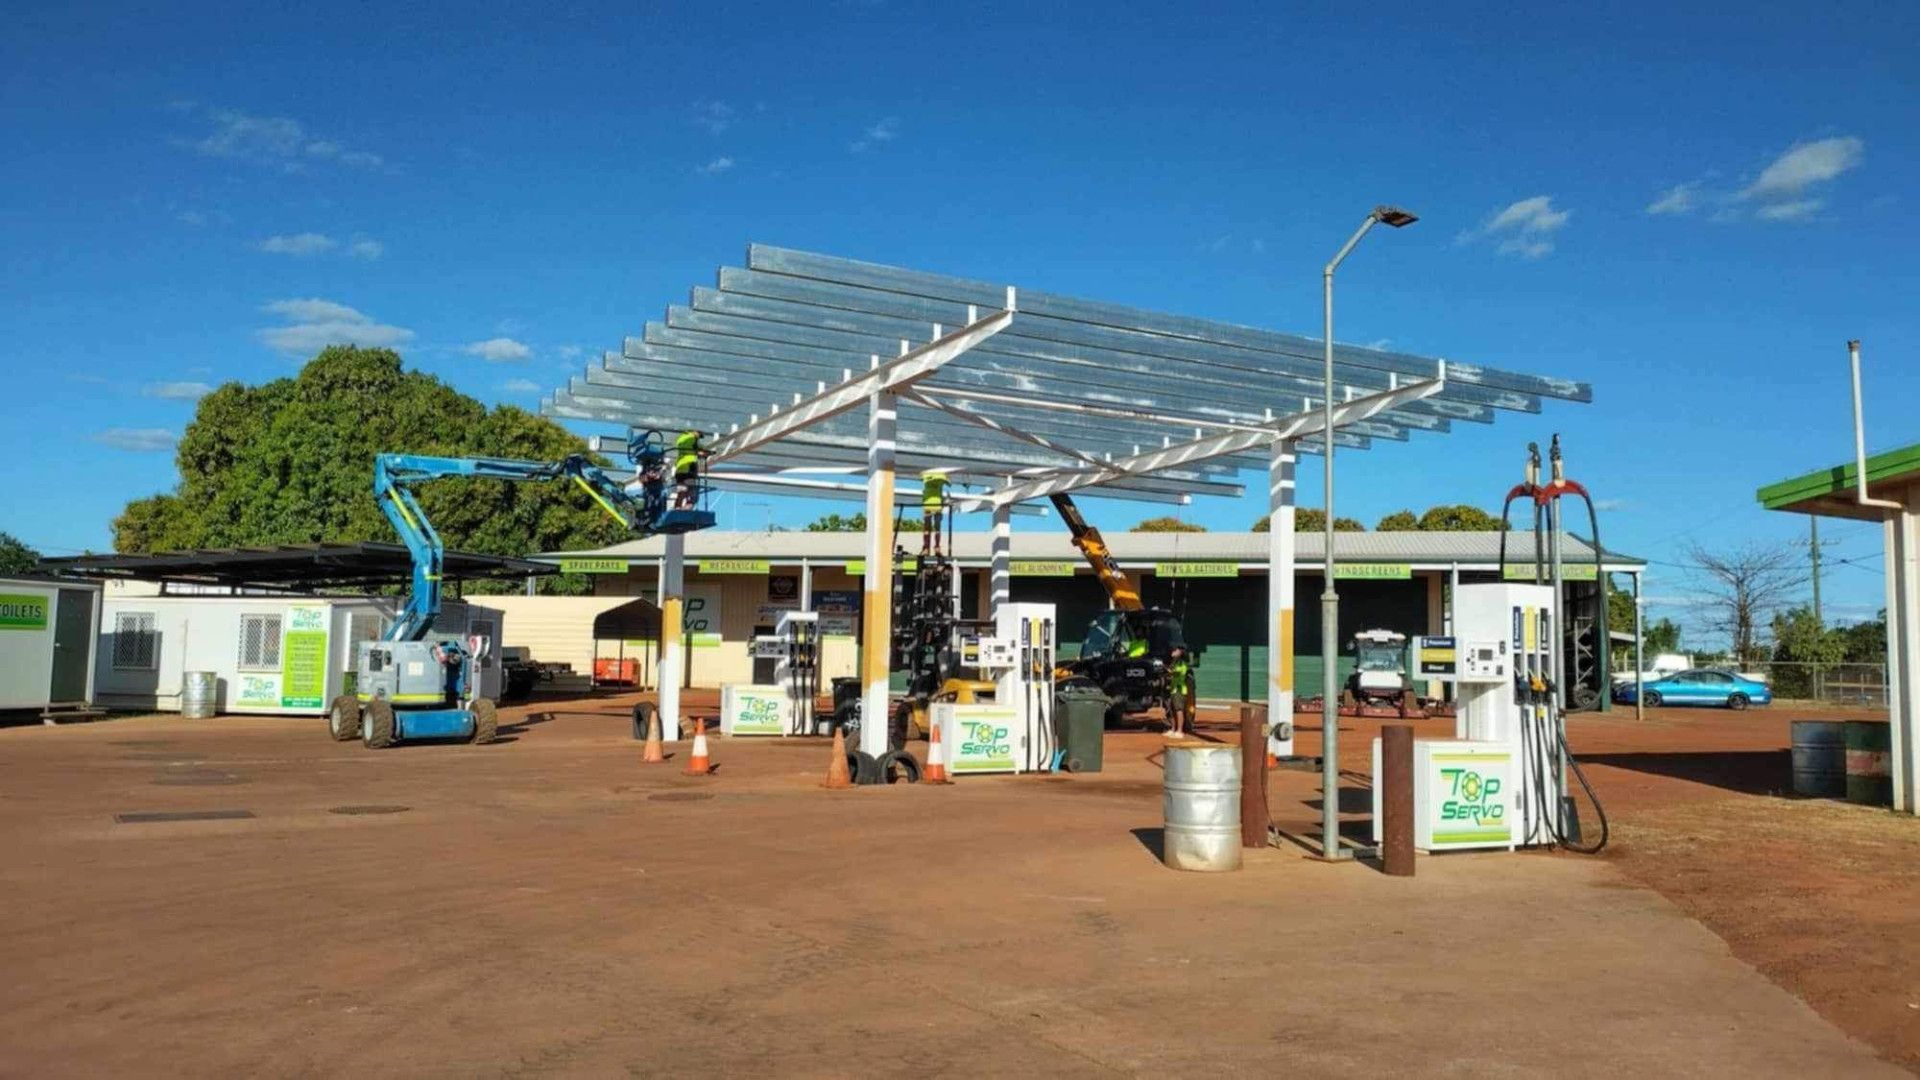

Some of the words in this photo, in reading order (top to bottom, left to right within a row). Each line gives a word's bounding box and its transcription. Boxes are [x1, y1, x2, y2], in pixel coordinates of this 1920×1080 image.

[569, 561, 593, 569] SPARE
[595, 561, 620, 569] PARTS
[709, 560, 761, 569] MECHANICAL
[0, 604, 42, 618] OILETS
